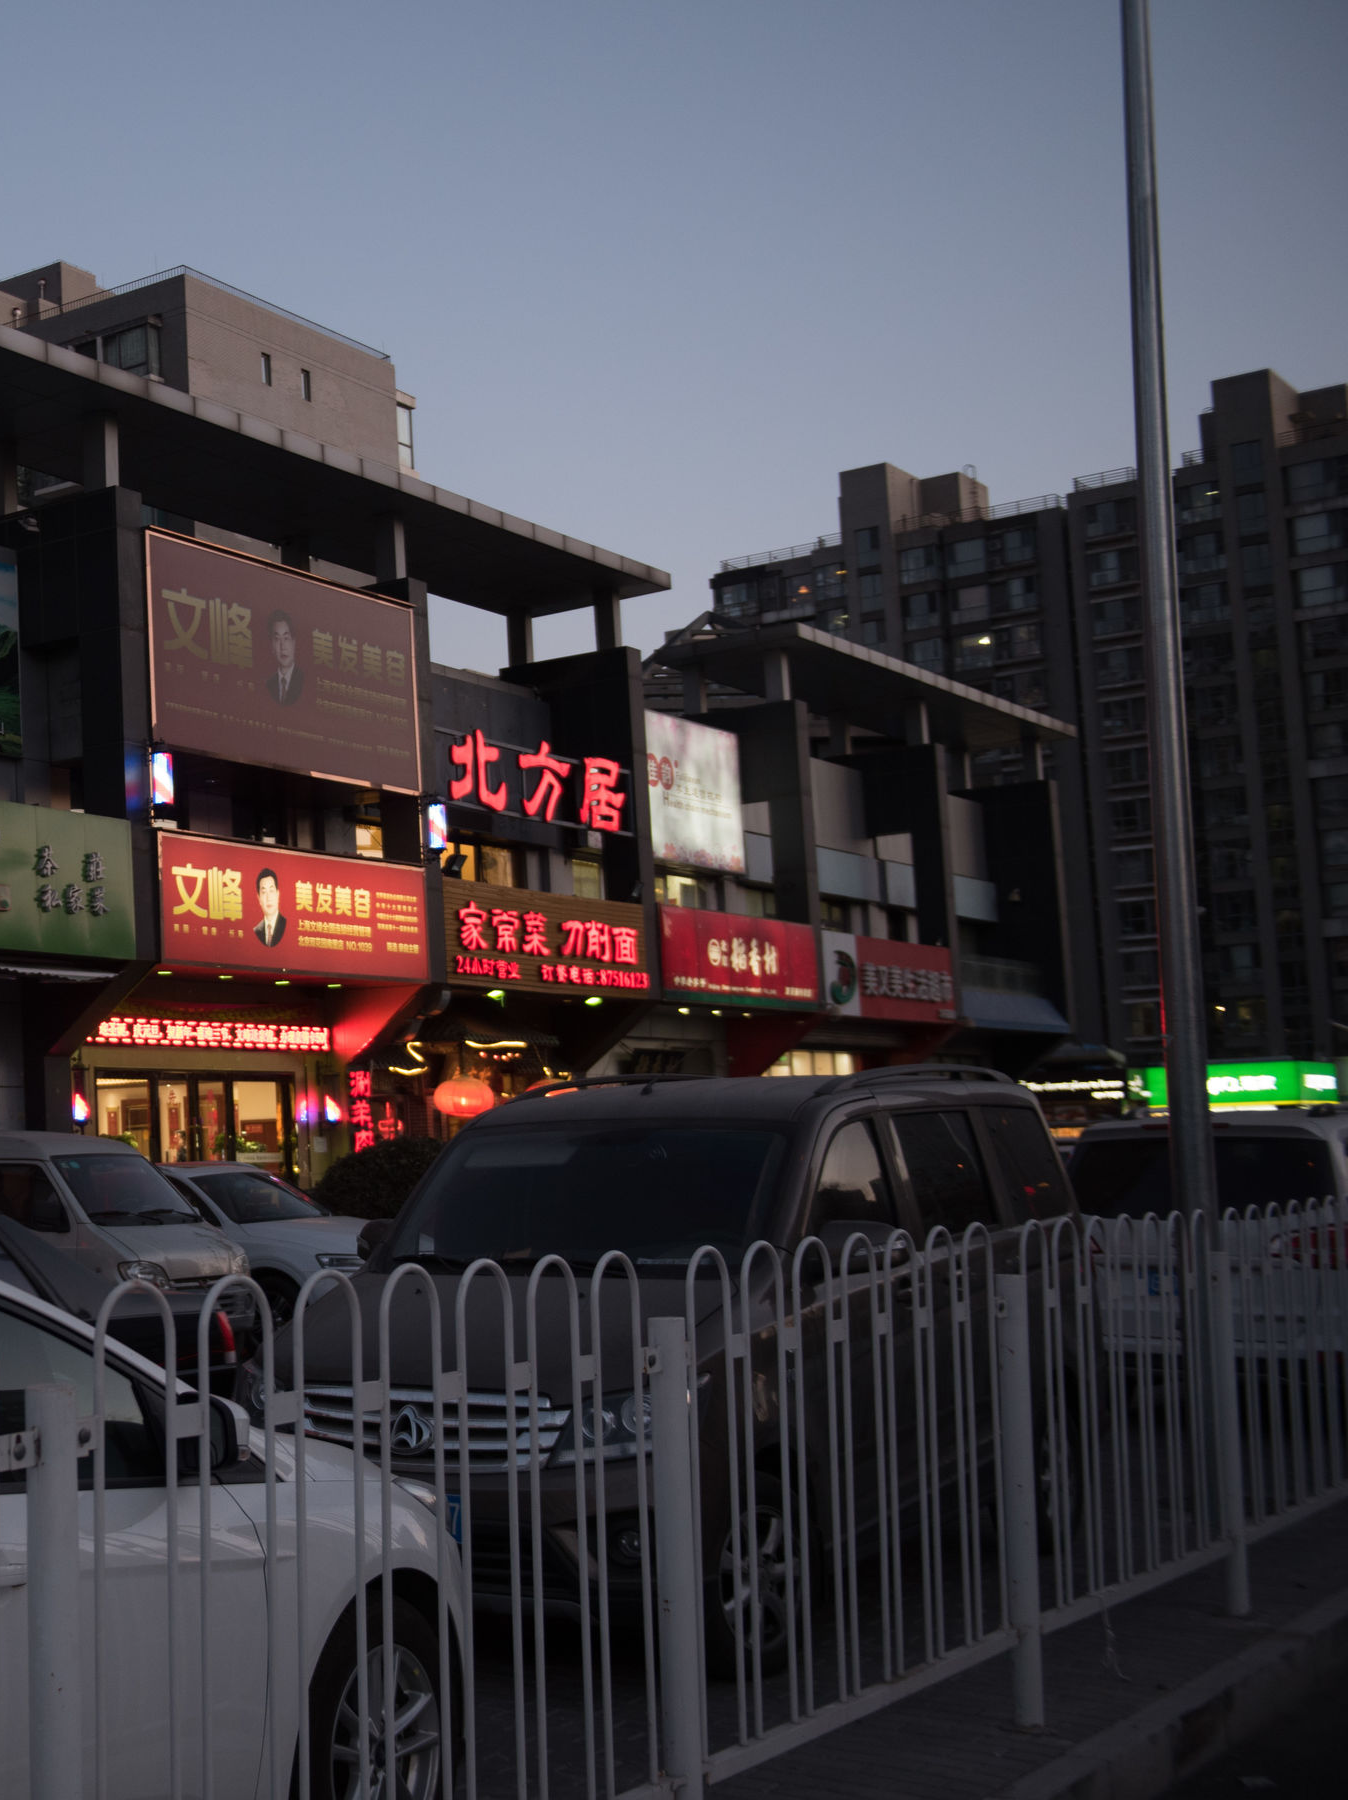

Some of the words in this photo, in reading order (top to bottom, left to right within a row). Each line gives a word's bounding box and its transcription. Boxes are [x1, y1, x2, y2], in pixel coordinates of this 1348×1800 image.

[161, 587, 252, 670] 文峰
[311, 628, 405, 688] 美发美容
[449, 728, 627, 833] 北方居
[171, 863, 243, 922] 文峰
[294, 879, 371, 919] 美发美容
[457, 900, 551, 957] 家常菜
[561, 920, 639, 965] 刀削面
[455, 955, 522, 980] 24小时营业
[349, 1070, 375, 1154] 涮羊肉
